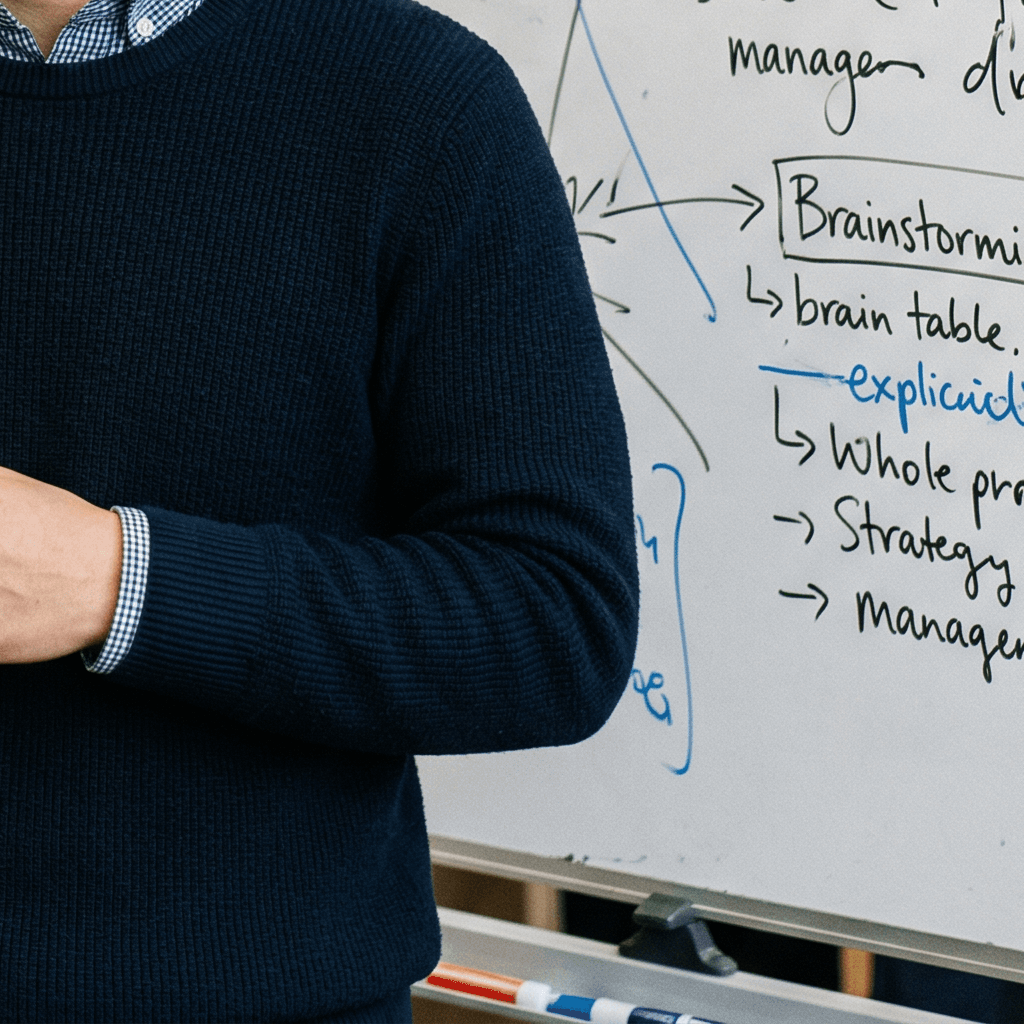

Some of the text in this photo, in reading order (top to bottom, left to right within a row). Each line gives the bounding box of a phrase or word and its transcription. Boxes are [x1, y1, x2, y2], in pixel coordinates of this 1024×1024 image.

[794, 272, 893, 335] brain
[830, 422, 956, 493] Whole
[833, 495, 1016, 608] Strategy
